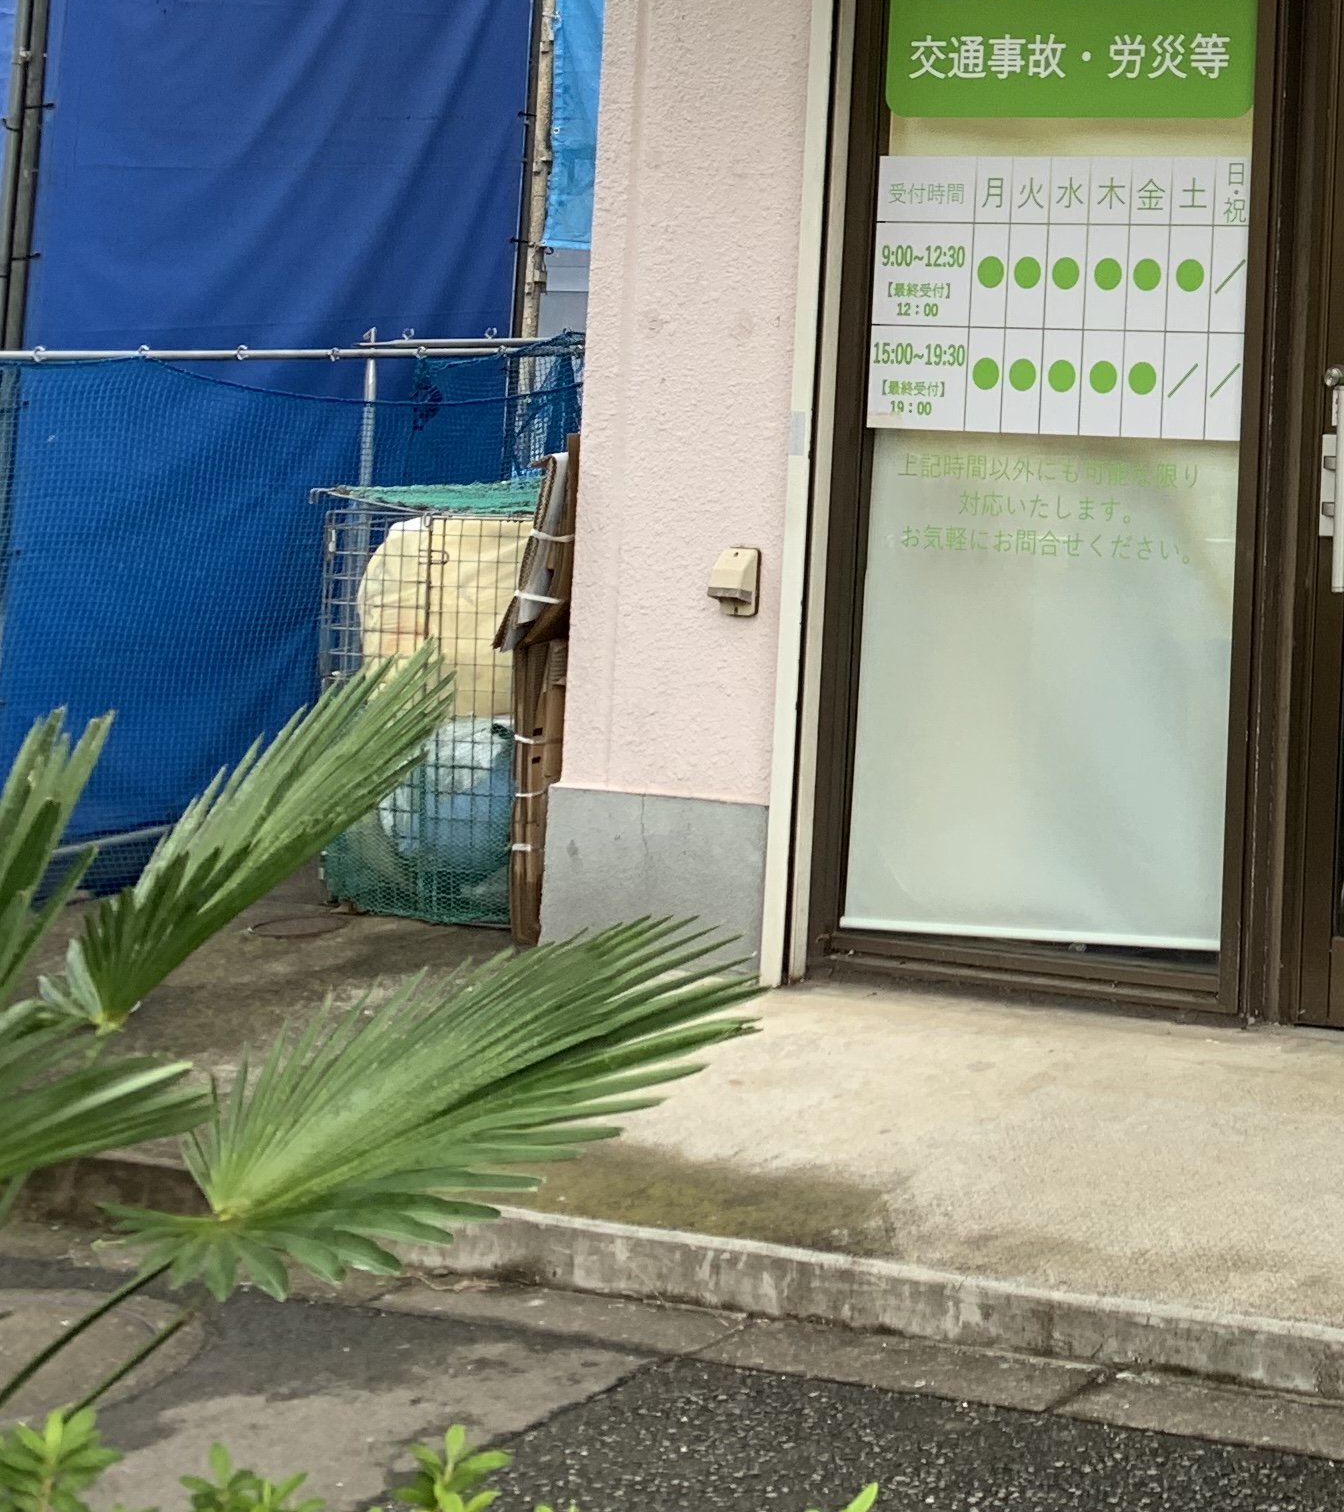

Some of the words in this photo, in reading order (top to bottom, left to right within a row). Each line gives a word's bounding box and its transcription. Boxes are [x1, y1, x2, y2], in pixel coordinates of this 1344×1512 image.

[908, 33, 1231, 80] 交通事故・労災等
[888, 183, 965, 205] 受付時間
[981, 177, 1005, 209] 月
[1017, 178, 1044, 209] 火
[1056, 177, 1084, 209] 水
[1097, 177, 1126, 210] 木
[1136, 179, 1166, 212] 金
[1178, 178, 1208, 210] 土
[958, 490, 1132, 525] 対応いたします。
